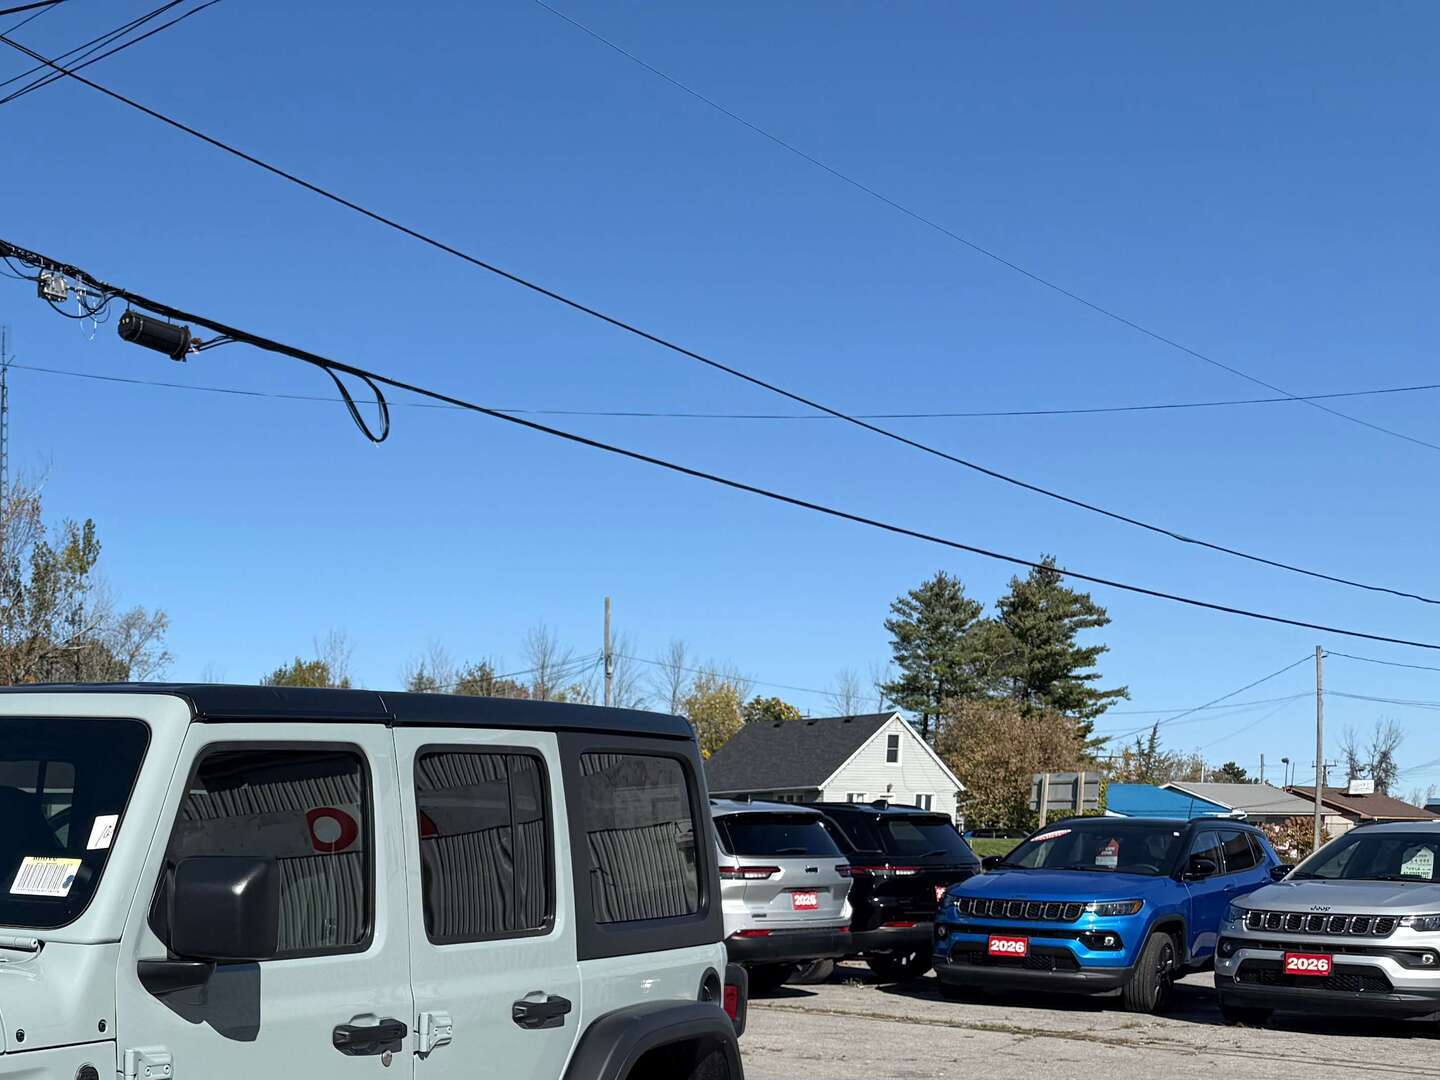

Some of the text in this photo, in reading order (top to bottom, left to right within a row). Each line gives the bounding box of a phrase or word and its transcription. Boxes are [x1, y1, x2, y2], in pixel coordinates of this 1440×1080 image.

[794, 893, 817, 906] 2026
[990, 939, 1025, 953] 2026
[1286, 957, 1329, 971] 2026
